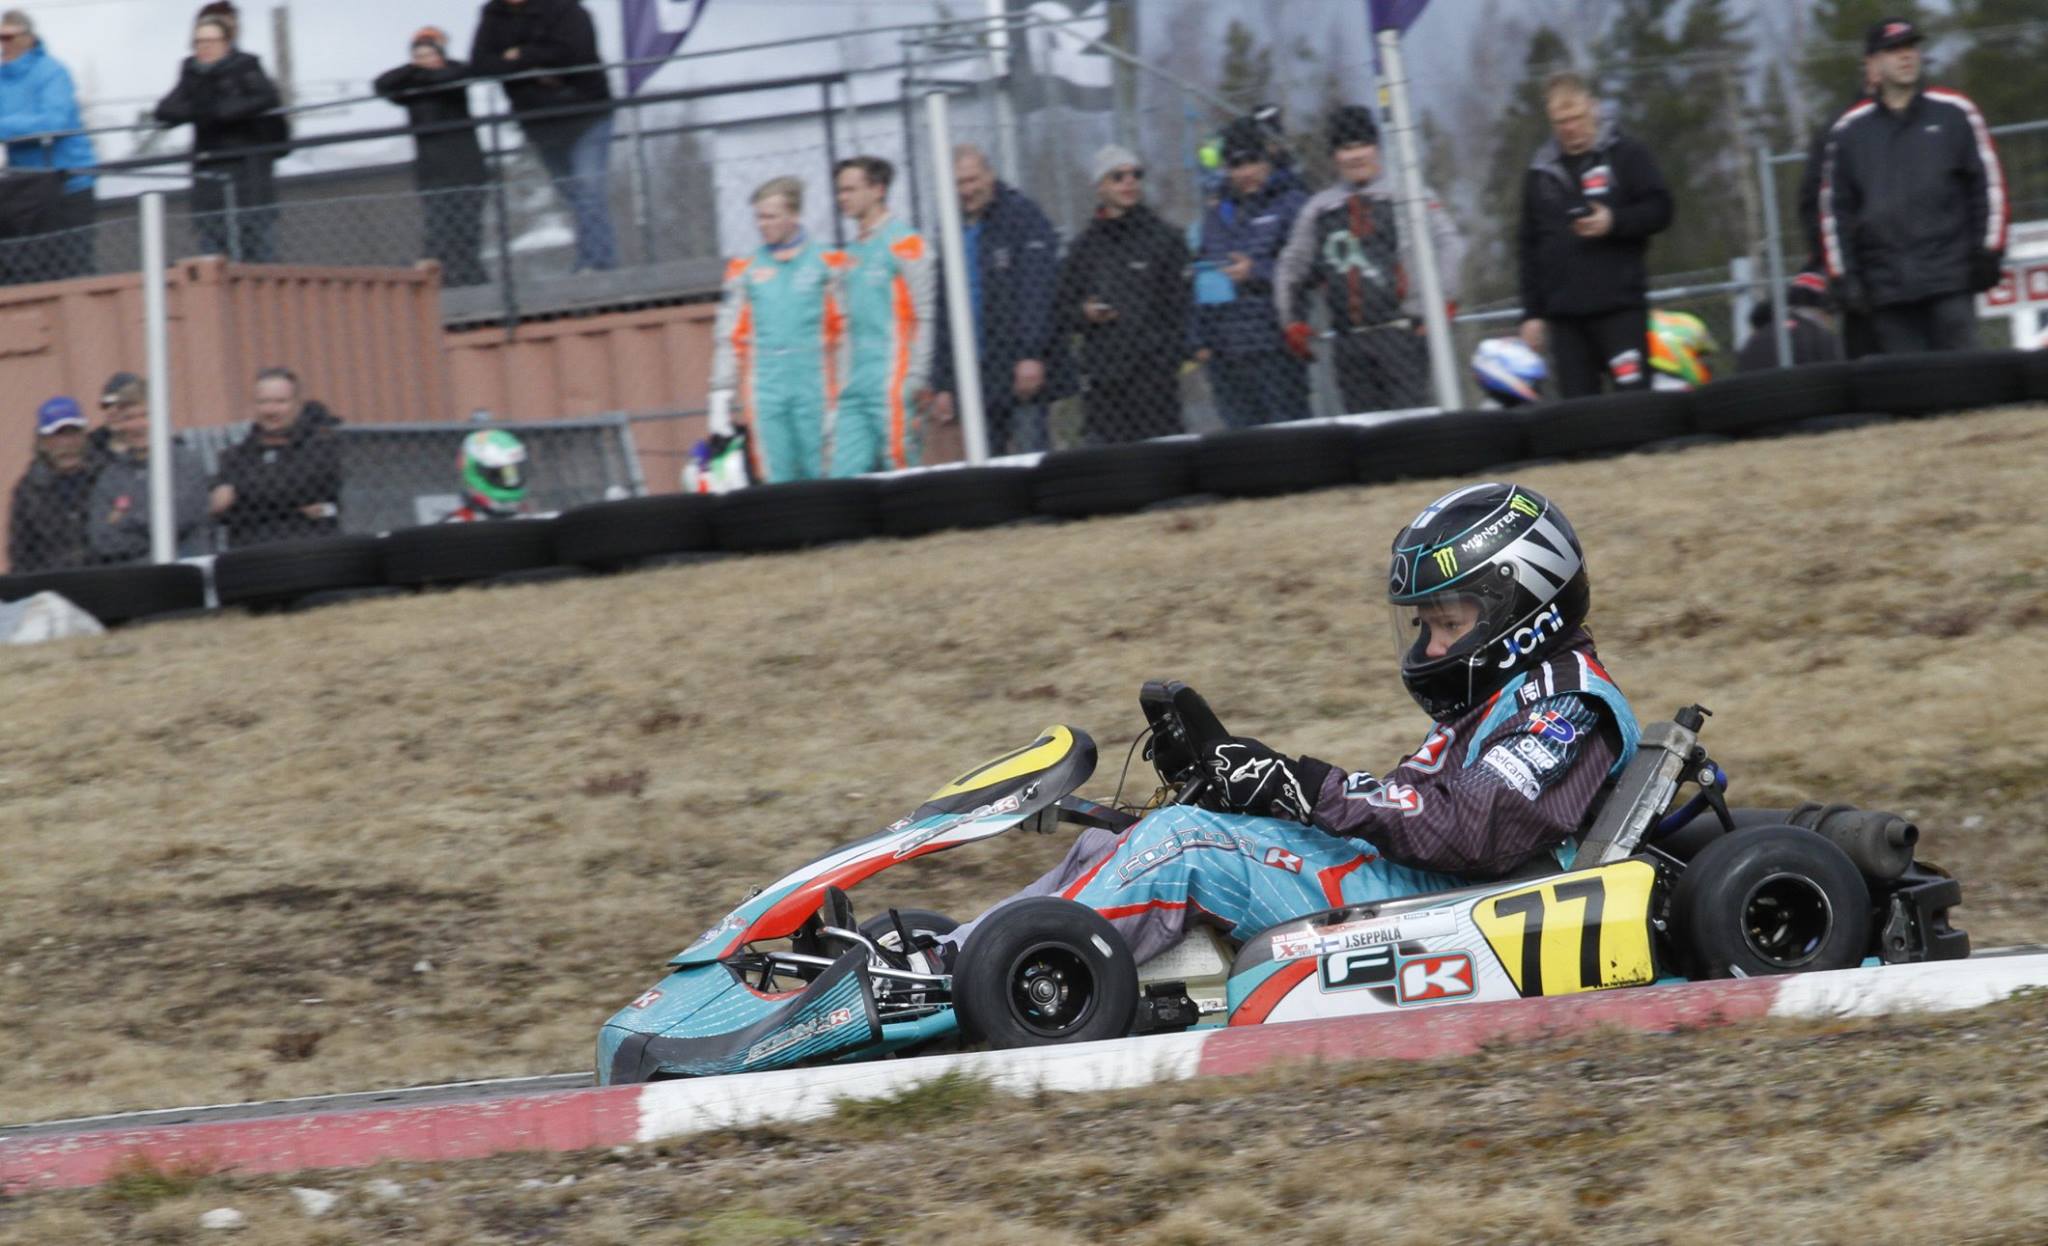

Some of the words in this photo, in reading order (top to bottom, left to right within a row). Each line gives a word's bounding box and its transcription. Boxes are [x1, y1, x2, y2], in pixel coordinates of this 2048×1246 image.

[1461, 510, 1520, 552] MONSTER
[1520, 739, 1555, 770] OMP
[1495, 876, 1605, 998] 77
